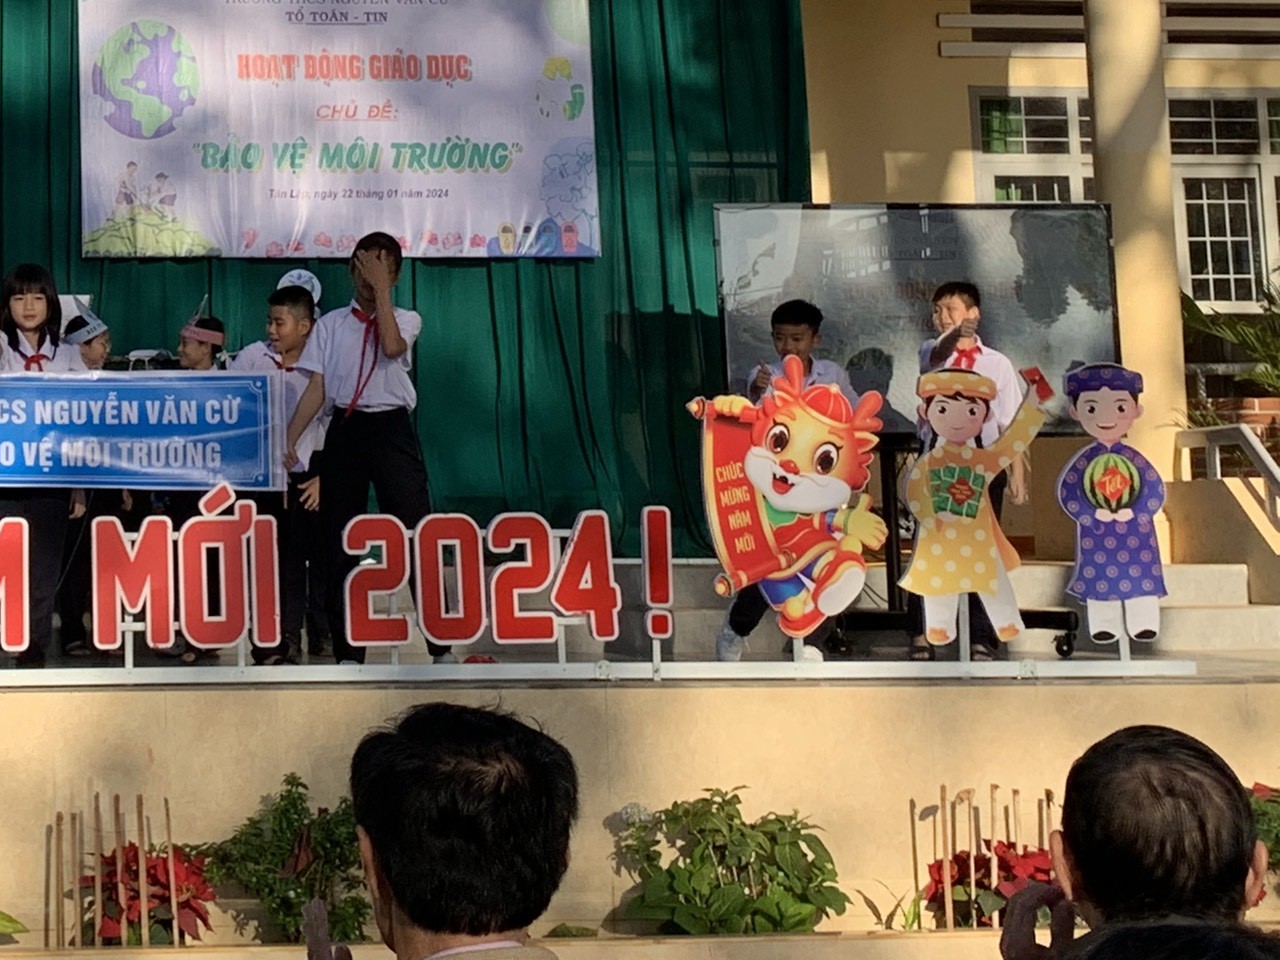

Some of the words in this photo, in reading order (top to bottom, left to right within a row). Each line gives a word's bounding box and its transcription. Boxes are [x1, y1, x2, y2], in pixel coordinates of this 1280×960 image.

[285, 6, 305, 23] TỔ
[310, 11, 349, 22] TOÁN
[364, 11, 388, 23] TIN
[237, 53, 298, 87] HOẠT
[304, 48, 364, 87] ĐỘNG
[426, 54, 472, 88] DỤC
[315, 98, 358, 119] CHỦ
[367, 99, 399, 120] ĐỀ:
[273, 136, 310, 175] VỆ
[320, 136, 382, 172] MÔI
[314, 189, 338, 201] ngày
[341, 190, 354, 199] 22
[356, 189, 383, 201] tháng
[386, 189, 399, 200] 01
[401, 189, 423, 200] năm
[426, 190, 449, 200] 2024
[34, 391, 138, 426] NGUYỄN
[146, 394, 197, 426] VĂN
[205, 393, 242, 426] CỪ
[22, 435, 54, 472] VỆ
[61, 436, 111, 468] MÔI
[118, 436, 222, 469] TRƯỜNG
[715, 461, 744, 483] CHÚC
[719, 485, 750, 508] MỪNG
[728, 509, 752, 531] NĂM
[734, 531, 756, 554] MỚI
[91, 481, 283, 651] MỚI
